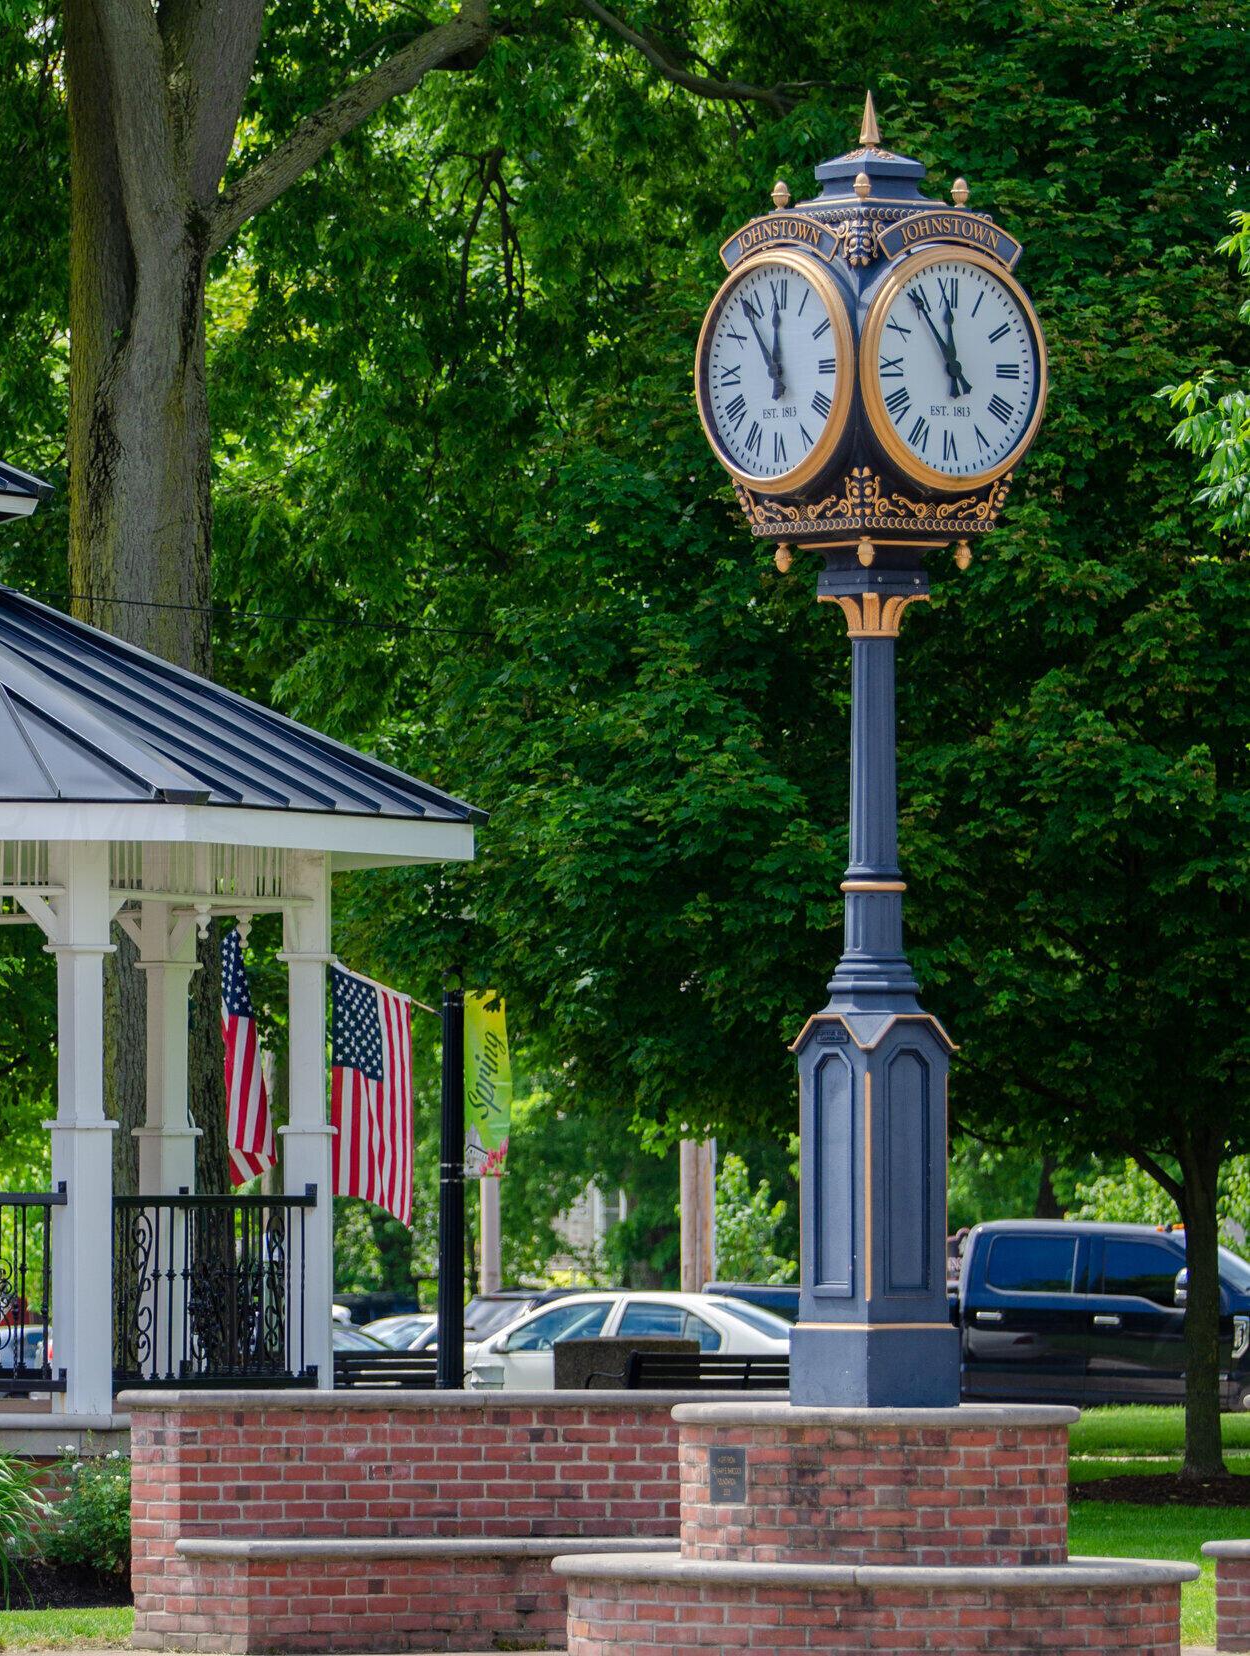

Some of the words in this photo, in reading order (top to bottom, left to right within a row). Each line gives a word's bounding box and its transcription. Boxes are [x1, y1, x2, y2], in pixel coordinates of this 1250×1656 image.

[737, 220, 821, 254] JOHNSTOWN
[900, 217, 1000, 250] JOHNSTOWN
[762, 408, 779, 420] EST.
[782, 406, 797, 418] 1813
[930, 405, 950, 417] EST.
[953, 406, 971, 418] 1813
[468, 1031, 507, 1120] Spring
